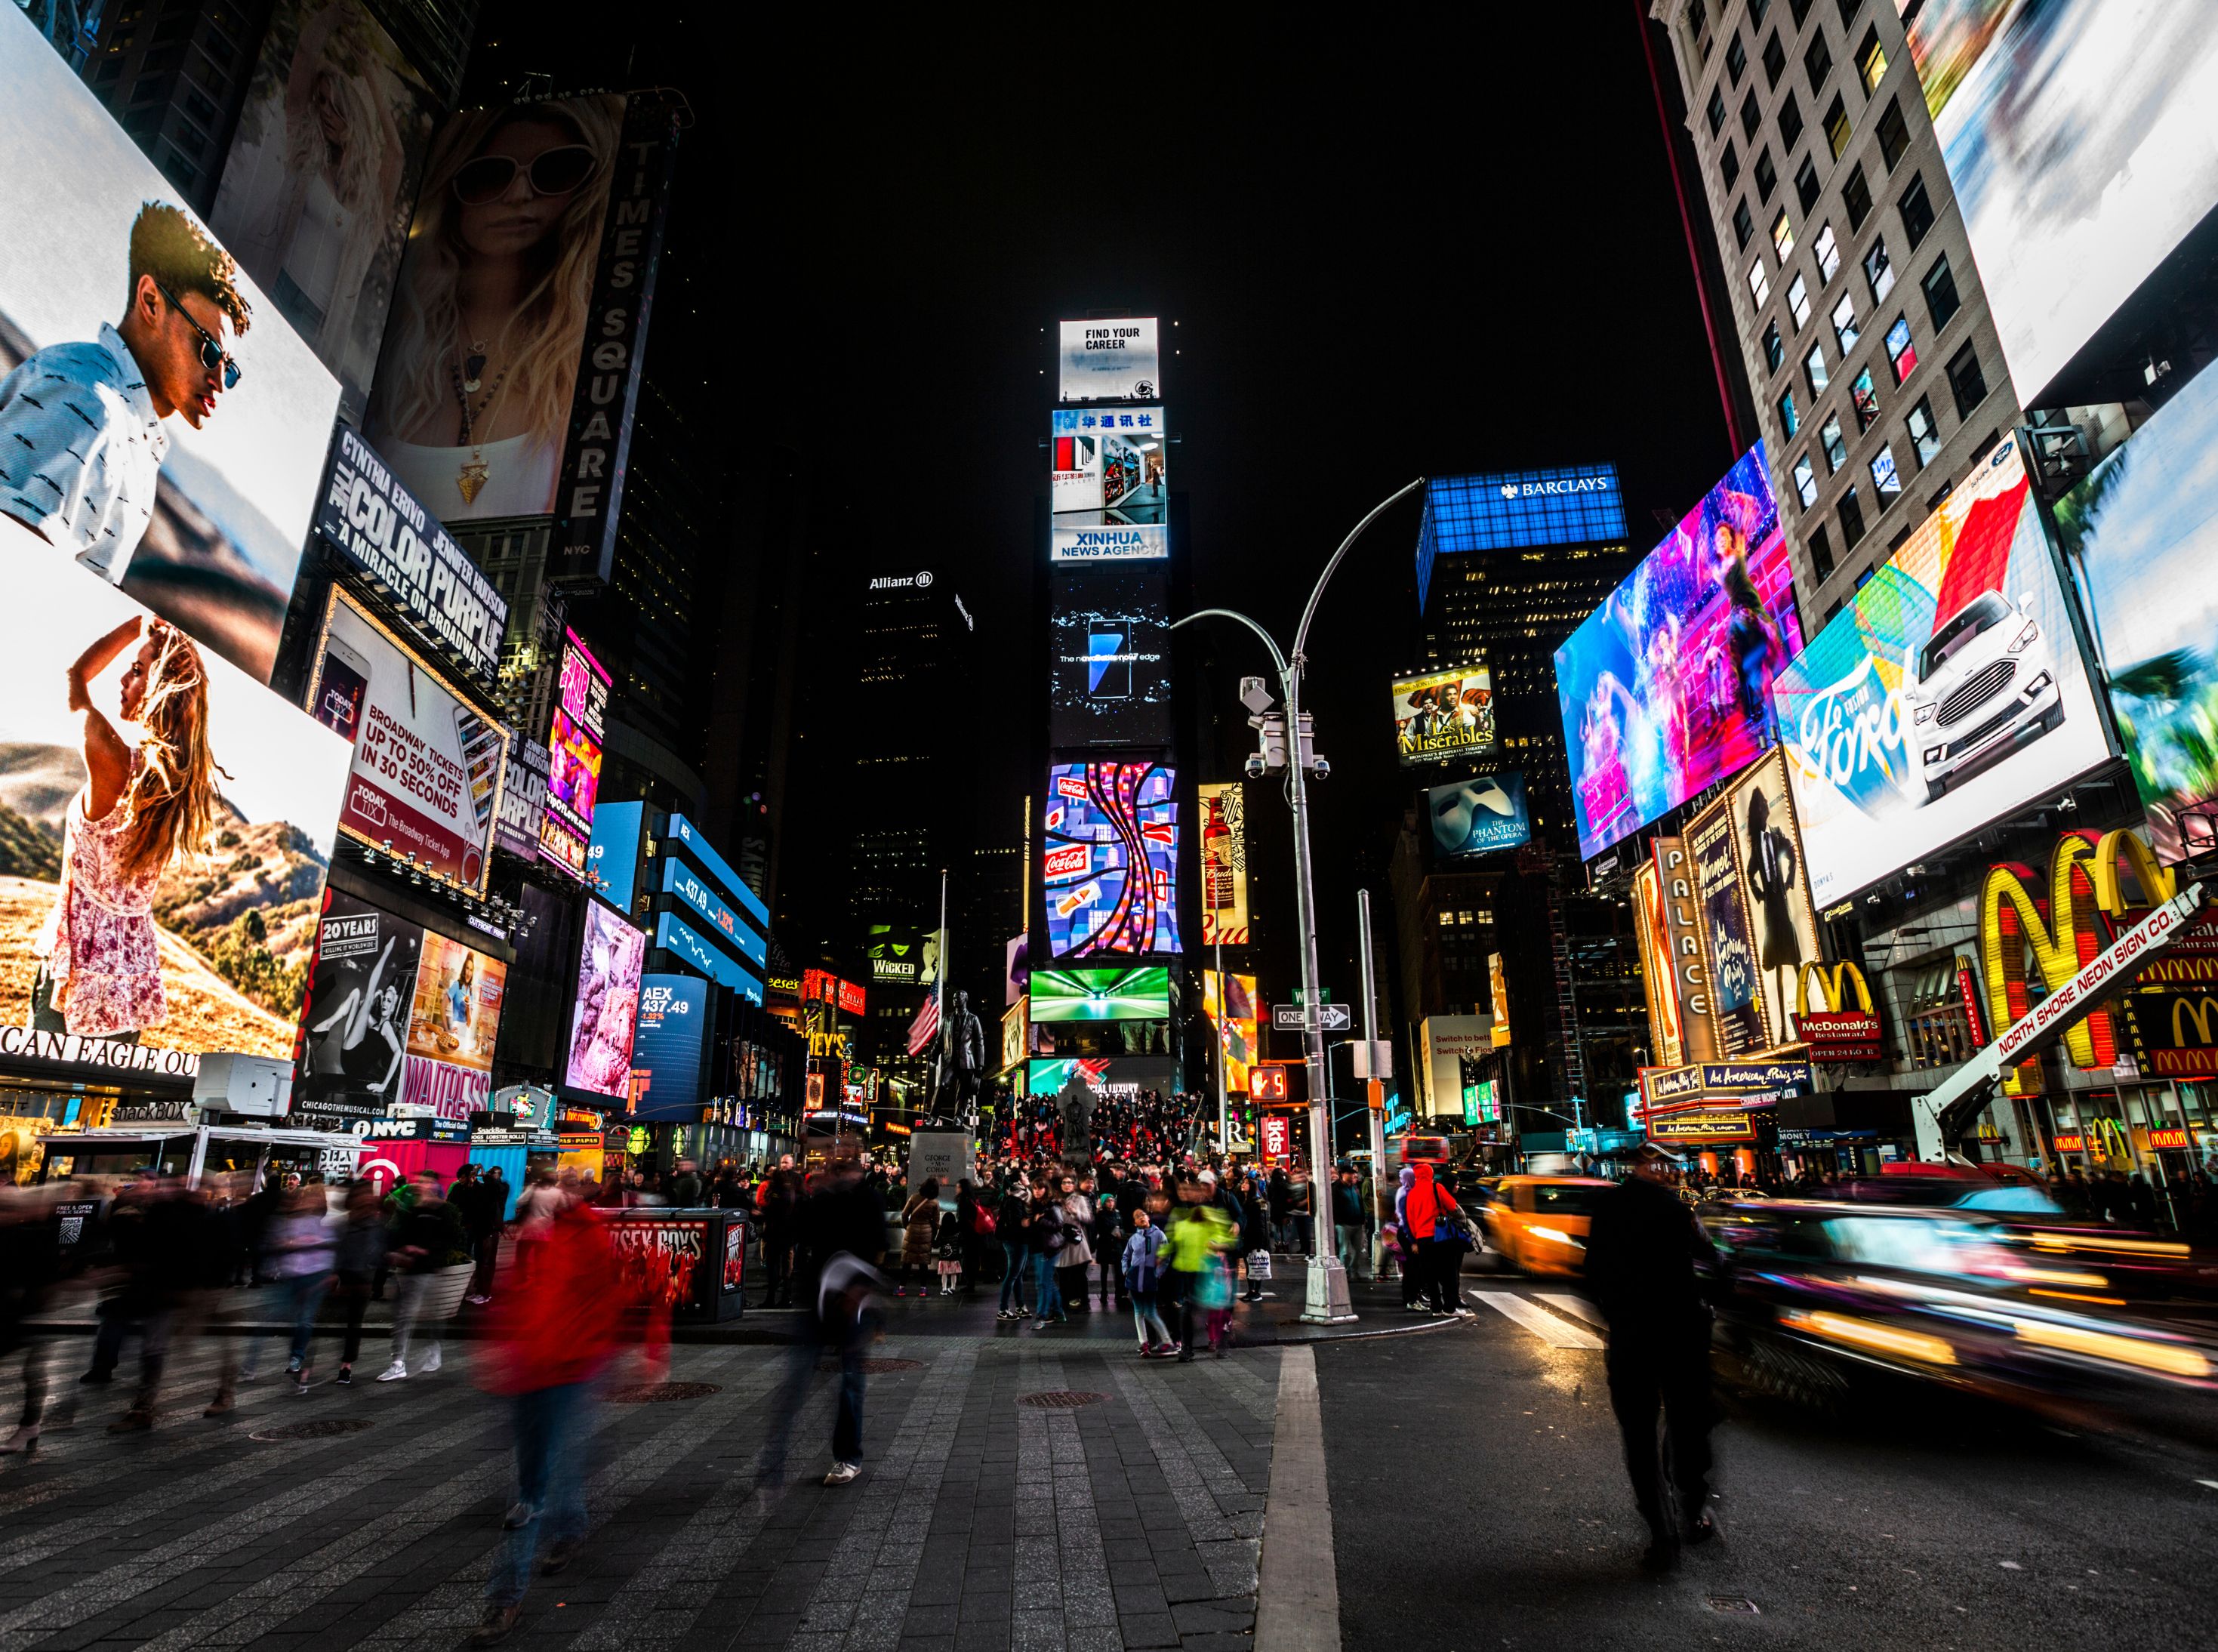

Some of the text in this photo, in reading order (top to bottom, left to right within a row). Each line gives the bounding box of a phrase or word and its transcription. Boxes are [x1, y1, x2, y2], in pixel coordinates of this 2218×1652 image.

[570, 140, 659, 518] TIMES SQUARE
[1086, 328, 1140, 339] FIND YOUR
[1086, 340, 1125, 350] CAREER
[1995, 444, 2010, 464] Ford
[328, 461, 356, 518] THE
[342, 430, 426, 533] CYNTHIA ERIVO
[1523, 477, 1607, 496] BARCLAYS
[1077, 532, 1143, 546] XINHUA
[563, 544, 590, 556] NYC
[1061, 544, 1159, 556] NEWS AGENCY
[347, 476, 504, 665] COLOR PURPLE
[350, 531, 429, 618] MIRACLE ON
[433, 530, 508, 624] JENNIFER HUDSON
[870, 577, 913, 590] Allianz
[1139, 654, 1160, 662] edge
[1412, 679, 1438, 690] MONTHS
[330, 689, 353, 710] TODAY
[334, 701, 347, 717] TIX
[1844, 686, 1869, 717] FUSION
[1432, 723, 1456, 735] Les
[369, 704, 464, 781] BROADWAY TICKETS
[525, 738, 547, 756] JENNIFER
[1400, 726, 1494, 754] Misérables
[365, 722, 462, 798] UP TO 50% OFF
[522, 748, 550, 775] HUDSON
[361, 742, 457, 818] IN 30 SECONDS
[504, 757, 547, 808] COLOR
[1060, 781, 1086, 796] Coca-Cola
[357, 784, 387, 809] TODAY
[362, 798, 377, 820] TIX
[389, 812, 450, 859] The Broadway Ticket App
[498, 822, 527, 842] ON BROADWAY
[681, 824, 690, 841] AEX
[1473, 822, 1526, 838] PHANTOM
[1501, 831, 1522, 840] OPERA
[587, 845, 604, 858] 49
[1046, 850, 1087, 874] Coca-Cola
[685, 878, 707, 911] 437.49
[716, 907, 734, 935] -1.32%
[322, 919, 376, 939] 20 YEARS
[469, 917, 505, 939] OUTFRONT PRIME
[1667, 849, 1708, 1014] PALACE
[325, 945, 342, 954] KILLING
[348, 942, 374, 951] WORLDWIDE
[1714, 938, 1749, 975] American
[1724, 960, 1745, 991] Paris
[1999, 1018, 2035, 1056] NORTH
[2036, 986, 2076, 1025] SHORE
[2077, 956, 2113, 994] NEON
[2114, 929, 2147, 964] SIGN
[2148, 911, 2173, 937] CO.
[642, 987, 673, 1000] AEX
[1295, 991, 1304, 1003] W
[1961, 975, 1970, 1000] OPEN
[642, 1000, 689, 1014] 437.49
[1281, 1012, 1303, 1022] ONE
[1802, 1020, 1878, 1031] McDonald's
[1815, 1031, 1866, 1039] Restaurant
[1968, 1009, 1979, 1042] HOURS
[1, 1028, 199, 1076] CAN EAGLE OU
[1710, 1067, 1791, 1085] An American Paris
[402, 1056, 489, 1121] WAITRESS
[1109, 1083, 1138, 1093] LUXURY
[1741, 1087, 1798, 1105] CHANGE MONEY ATM
[303, 1101, 385, 1116] CHICAGOTHEMUSICAL.COM
[712, 1096, 751, 1128] 1585
[372, 1120, 416, 1136] NYC
[443, 1121, 455, 1130] Official
[456, 1122, 467, 1130] Guide
[1675, 1124, 1699, 1133] American
[1702, 1123, 1715, 1133] Paris
[1268, 1120, 1284, 1153] tkts
[1849, 1146, 1857, 1169] MONEY
[658, 1229, 701, 1261] BOYS
[728, 1226, 743, 1247] JERSEY
